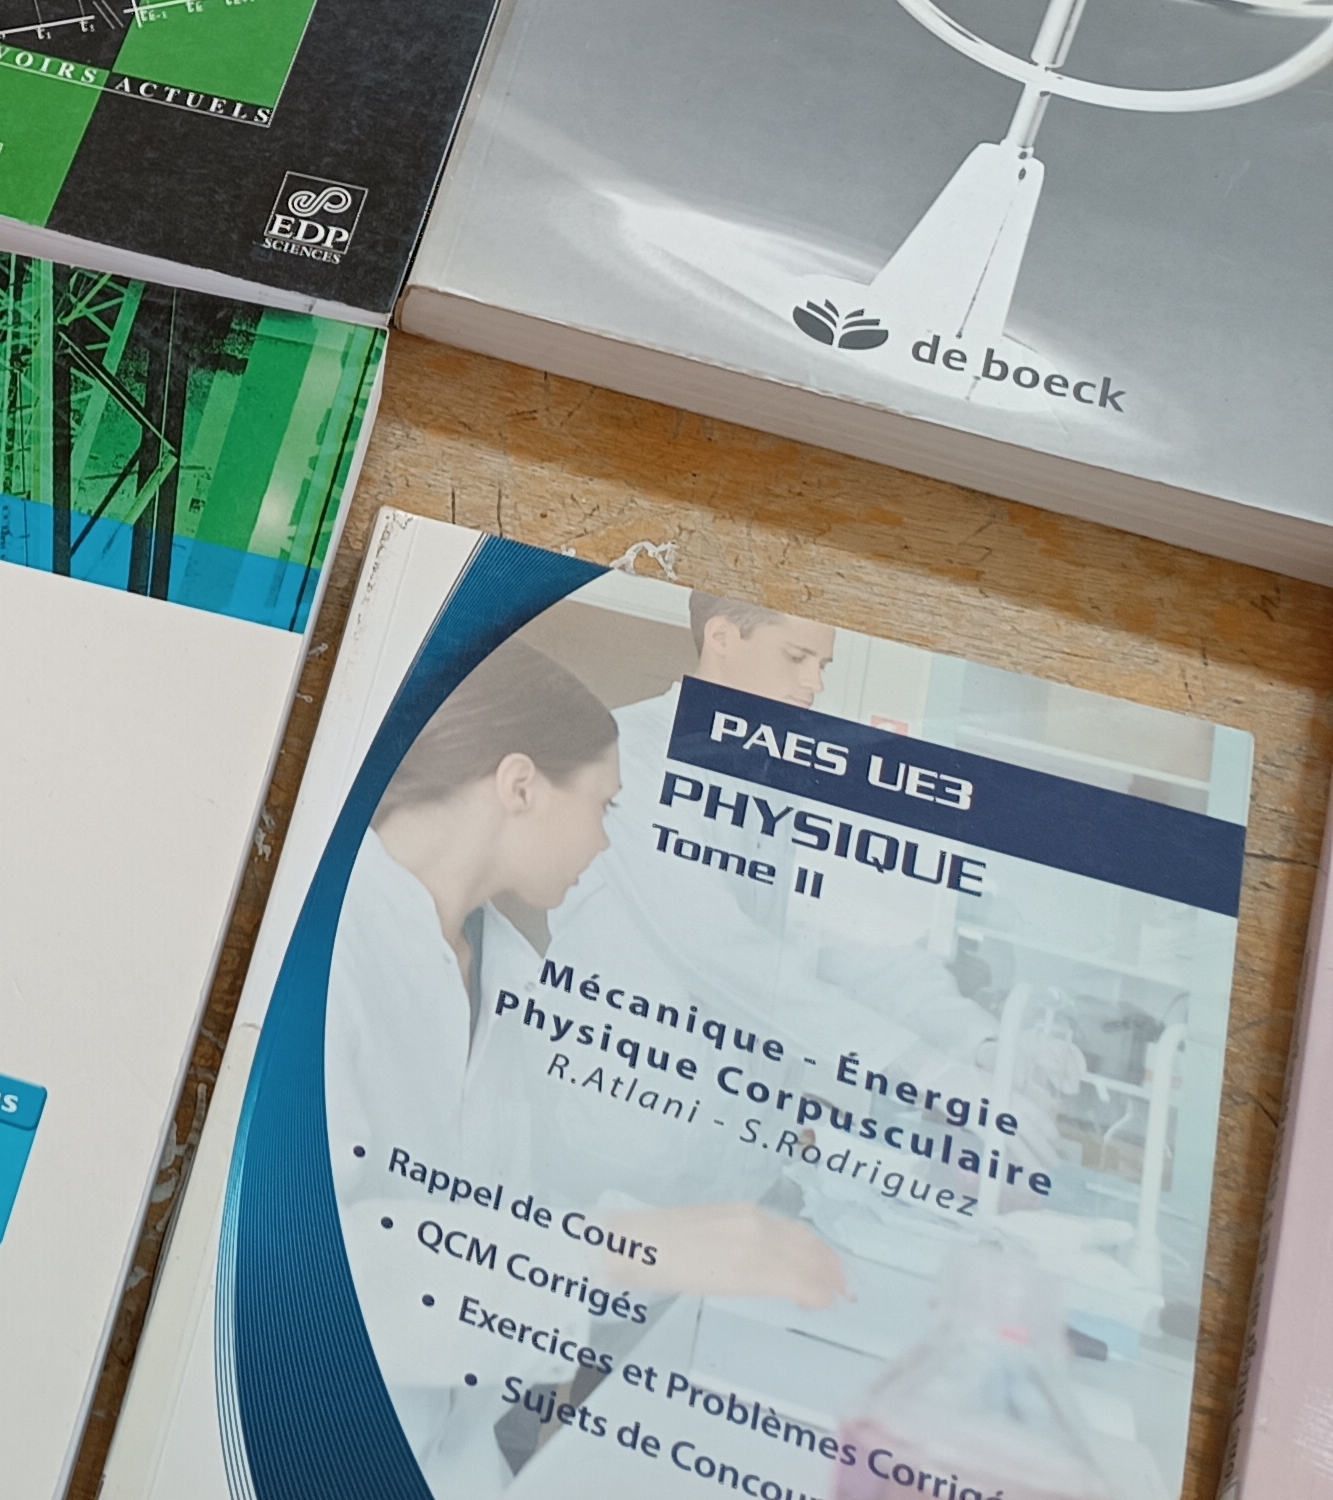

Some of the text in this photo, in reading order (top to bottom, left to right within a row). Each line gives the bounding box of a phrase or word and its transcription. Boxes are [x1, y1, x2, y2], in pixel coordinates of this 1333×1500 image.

[910, 332, 1128, 414] de boeck
[708, 708, 977, 812] PAES UE3
[652, 823, 825, 900] Tome II
[656, 770, 990, 897] PHYSIQUE
[416, 1217, 652, 1328] QCM Corrigés
